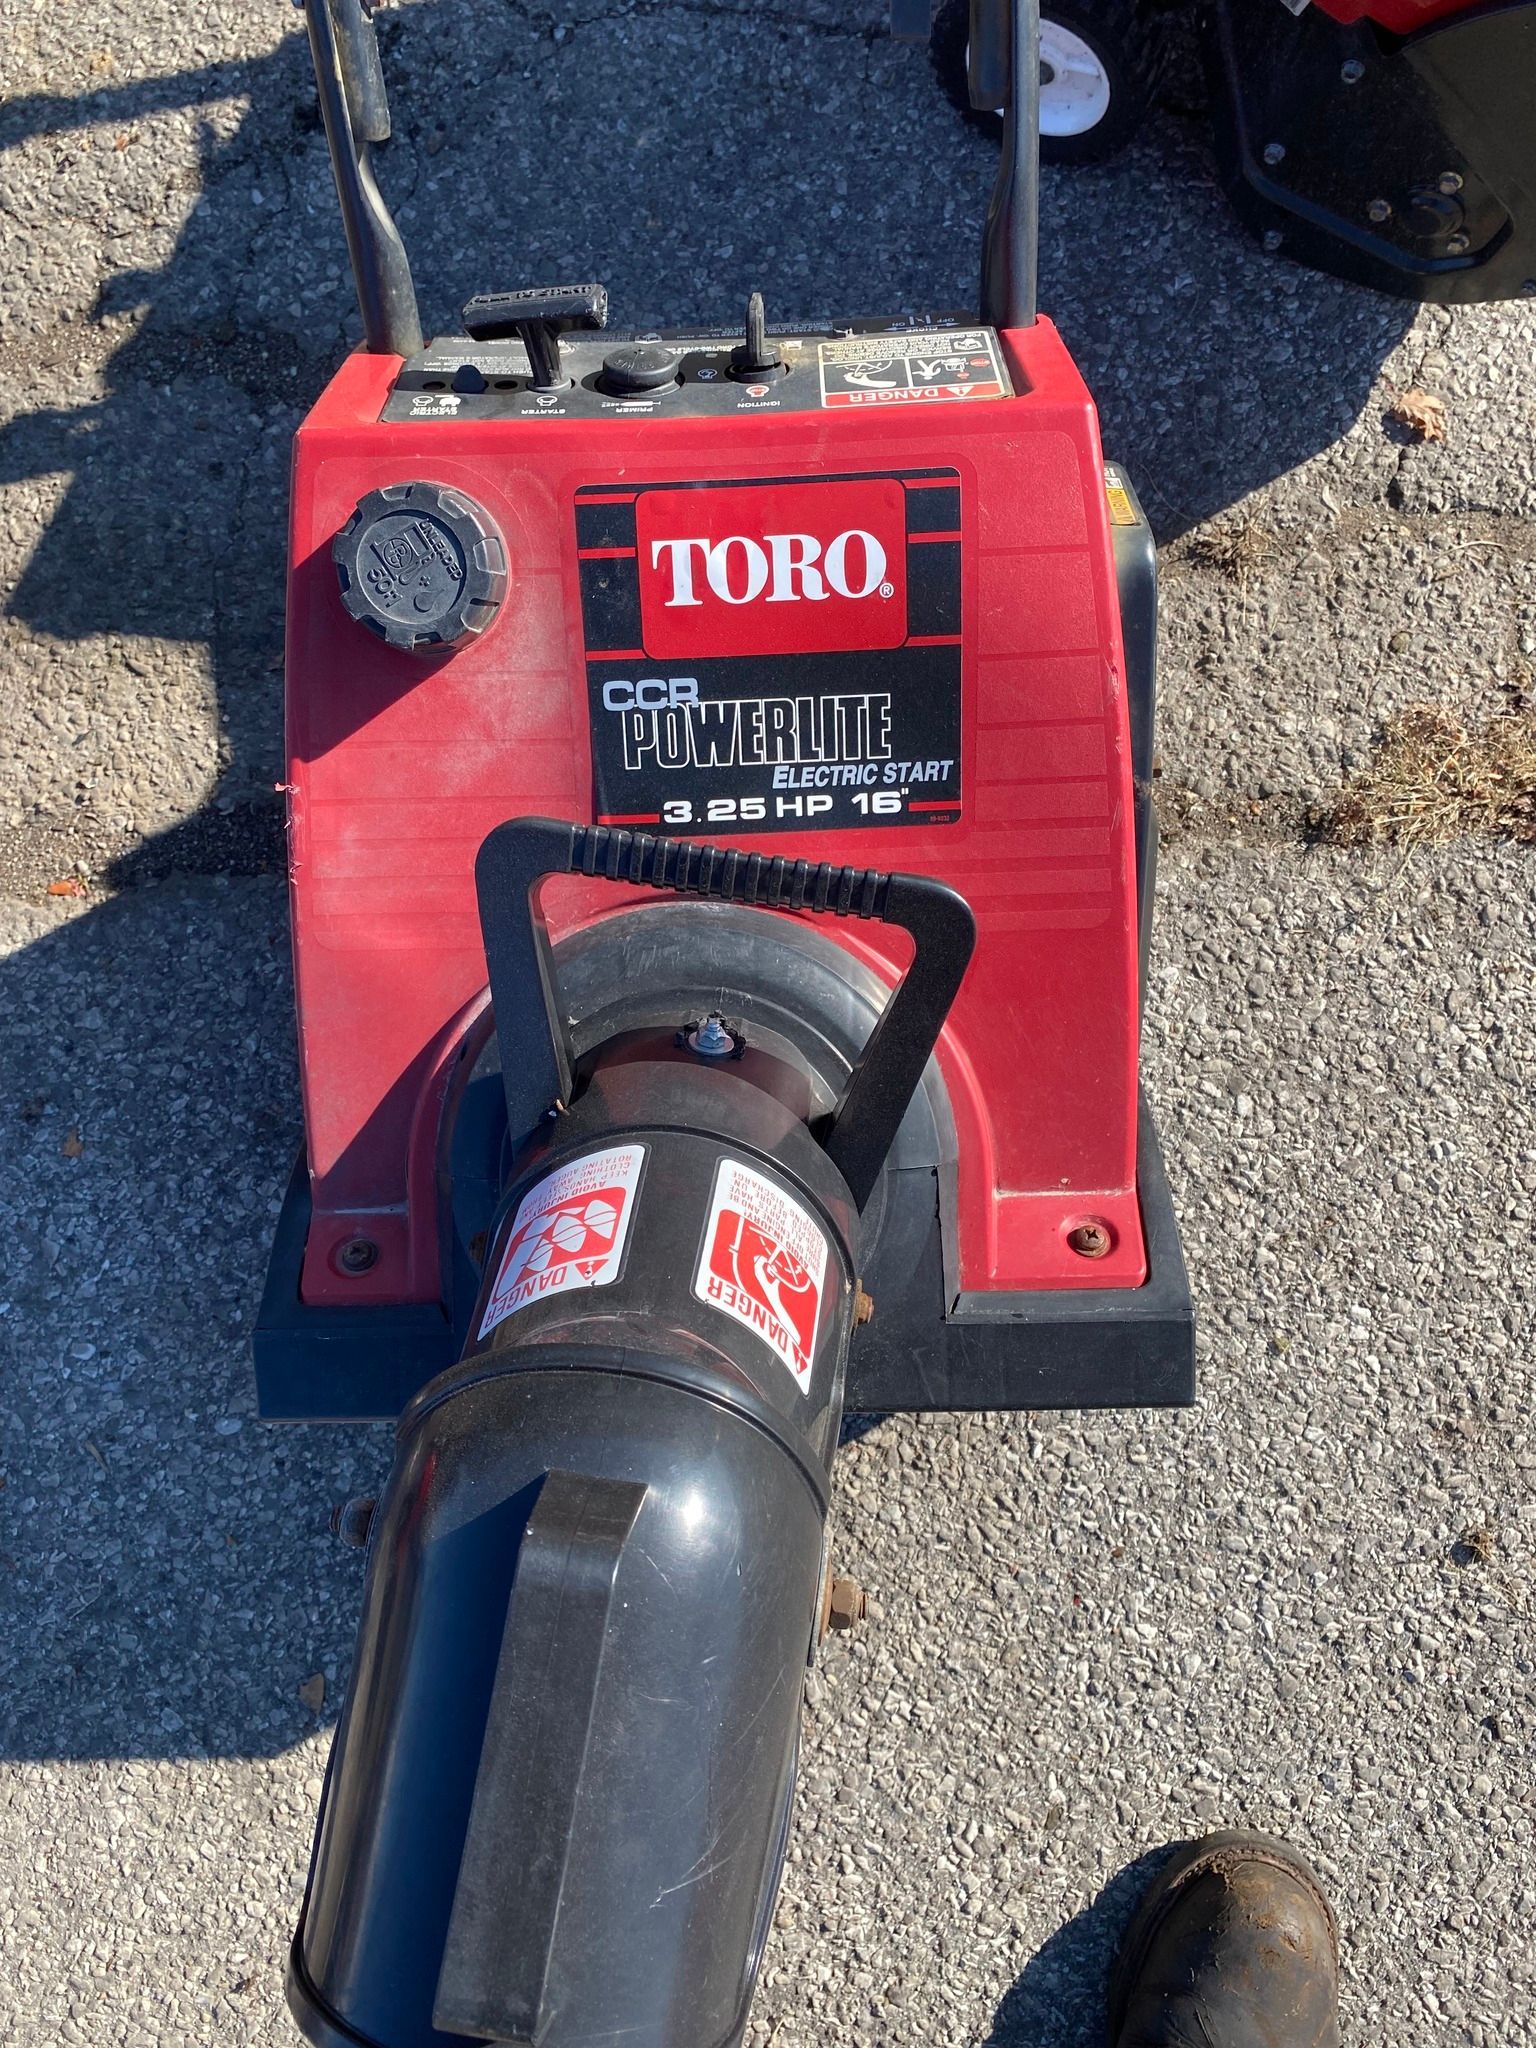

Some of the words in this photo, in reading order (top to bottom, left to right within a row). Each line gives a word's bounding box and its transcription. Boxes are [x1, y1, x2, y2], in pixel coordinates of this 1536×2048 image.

[737, 400, 781, 408] IGNITION
[849, 387, 939, 402] DANGER
[418, 519, 463, 582] UNLEADED
[651, 529, 887, 607] TORO
[602, 677, 699, 712] CCR
[621, 693, 892, 770] POWERLITE
[771, 763, 878, 789] ELECTRIC
[882, 760, 953, 783] START
[662, 797, 766, 824] 3.25
[776, 794, 833, 818] HP
[850, 787, 909, 816] 16"
[571, 1180, 606, 1197] AVOID
[727, 1192, 740, 1204] BE
[728, 1184, 754, 1203] HAVE
[741, 1199, 761, 1215] AND
[743, 1211, 784, 1243] INJURY!
[785, 1241, 809, 1270] AVOID
[485, 1266, 568, 1329] DANGER
[707, 1276, 788, 1353] DANGER
